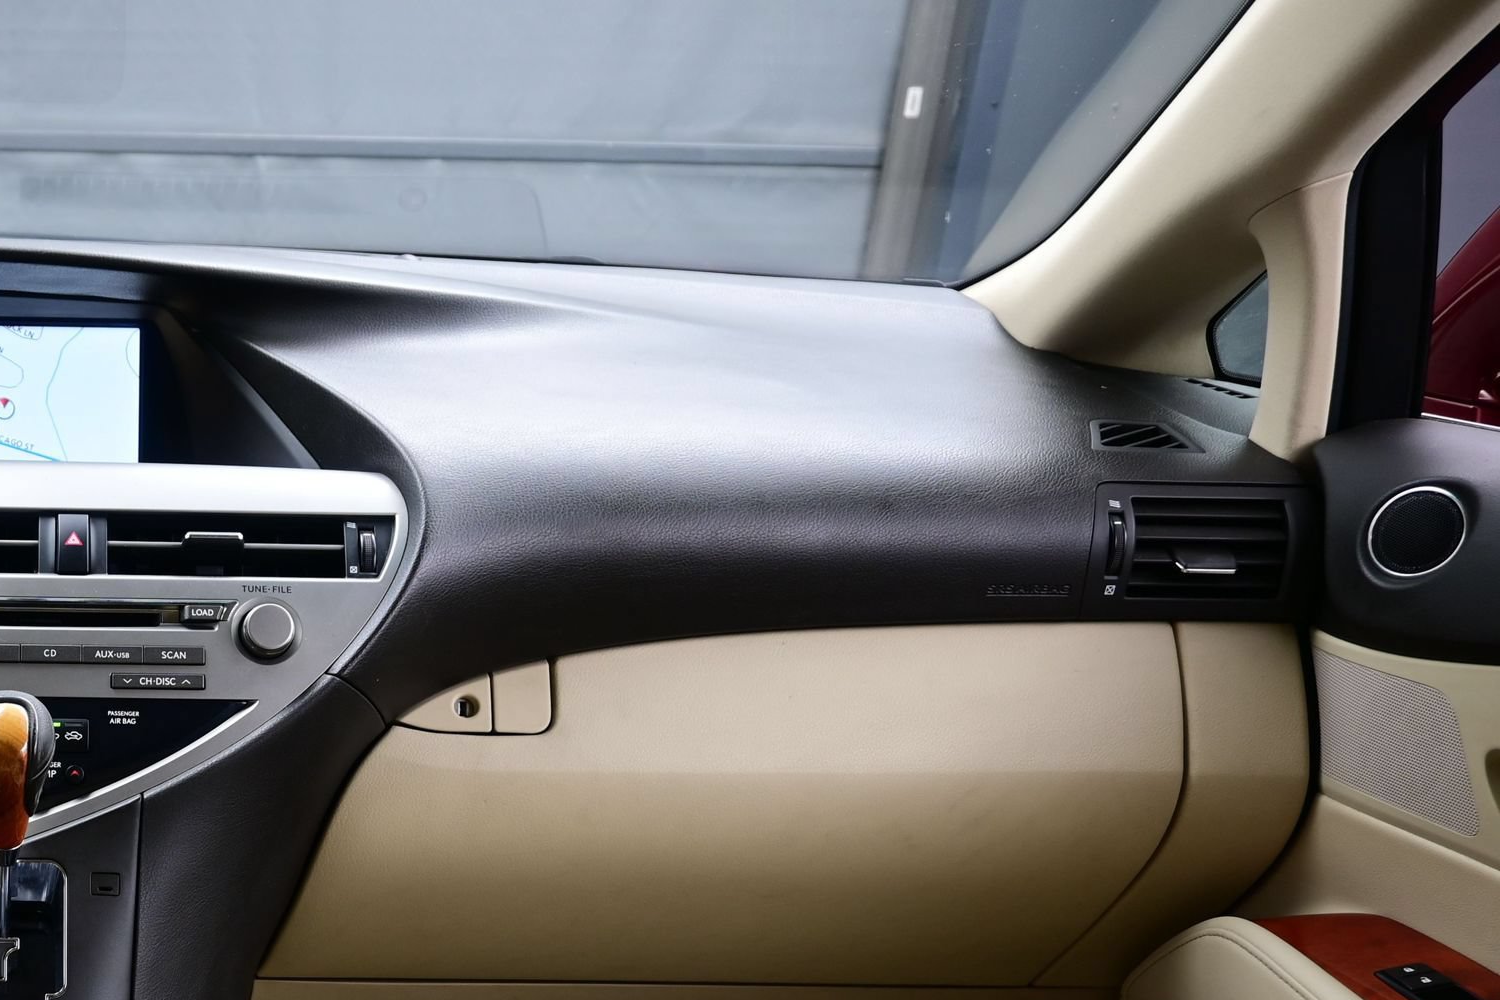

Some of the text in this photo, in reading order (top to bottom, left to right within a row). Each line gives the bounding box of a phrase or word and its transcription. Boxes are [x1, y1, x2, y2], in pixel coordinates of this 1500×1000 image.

[25, 443, 35, 451] ST
[191, 608, 214, 617] LOAD
[42, 649, 57, 659] CD
[160, 651, 187, 660] SCAN
[107, 710, 140, 718] PASSENGER
[121, 718, 137, 726] BAG
